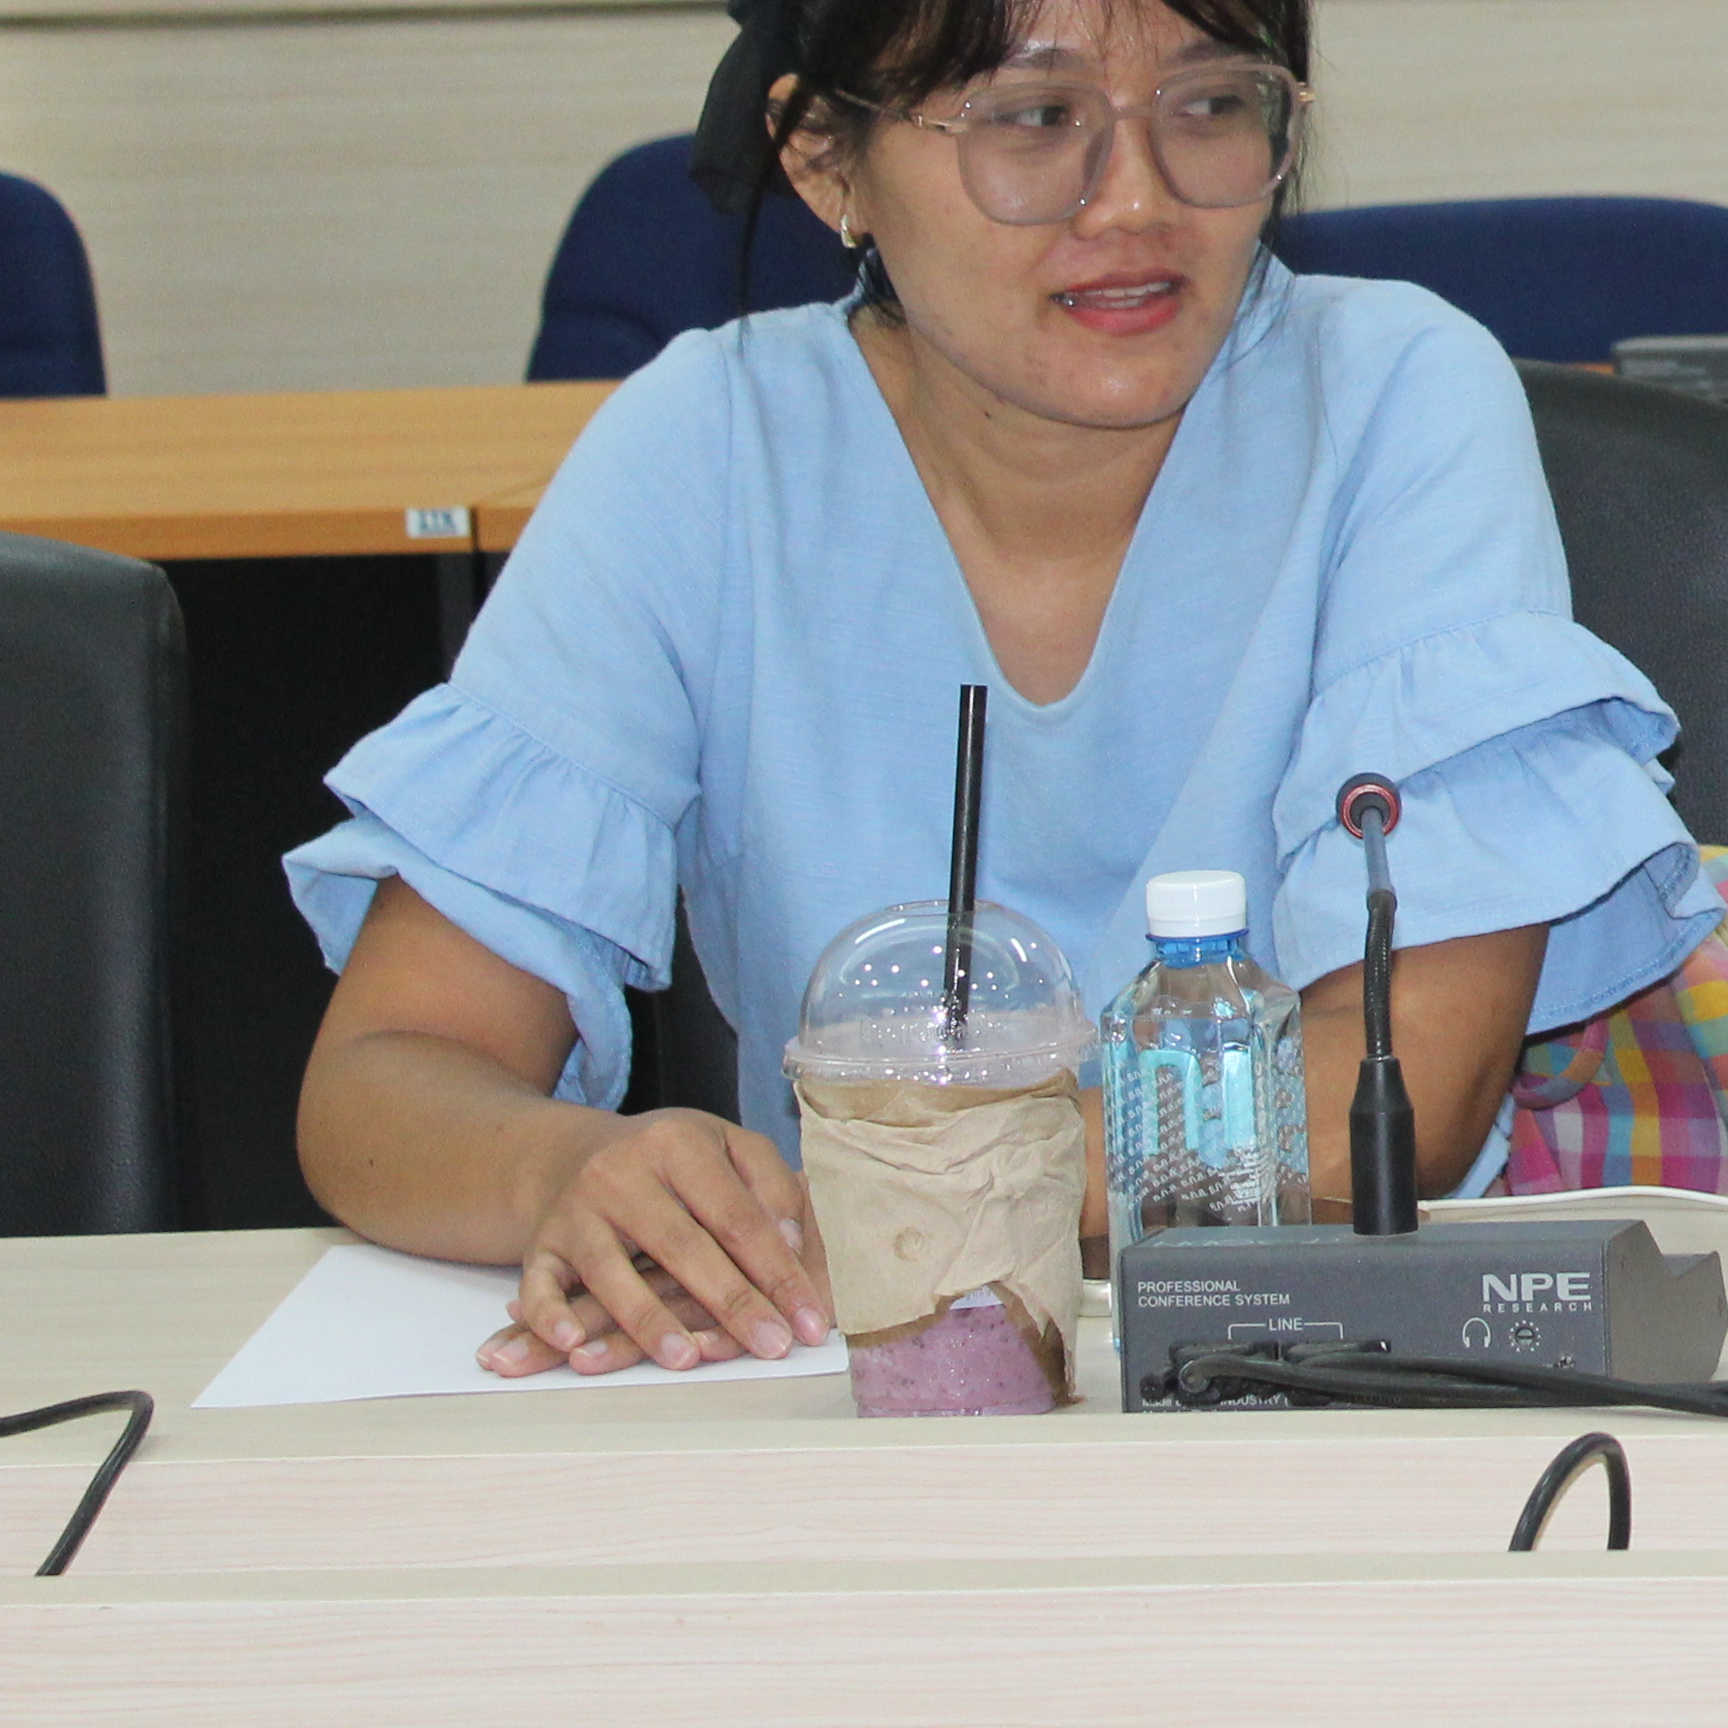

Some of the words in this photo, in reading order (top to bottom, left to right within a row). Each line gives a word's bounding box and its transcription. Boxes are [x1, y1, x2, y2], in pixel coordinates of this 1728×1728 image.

[1137, 1280, 1241, 1294] PROFESSIONAL
[1483, 1272, 1591, 1302] NPE
[1138, 1294, 1230, 1308] CONFERENCE
[1235, 1293, 1290, 1306] SYSTEM
[1483, 1302, 1592, 1314] RESEARCH
[1268, 1318, 1304, 1332] LINE
